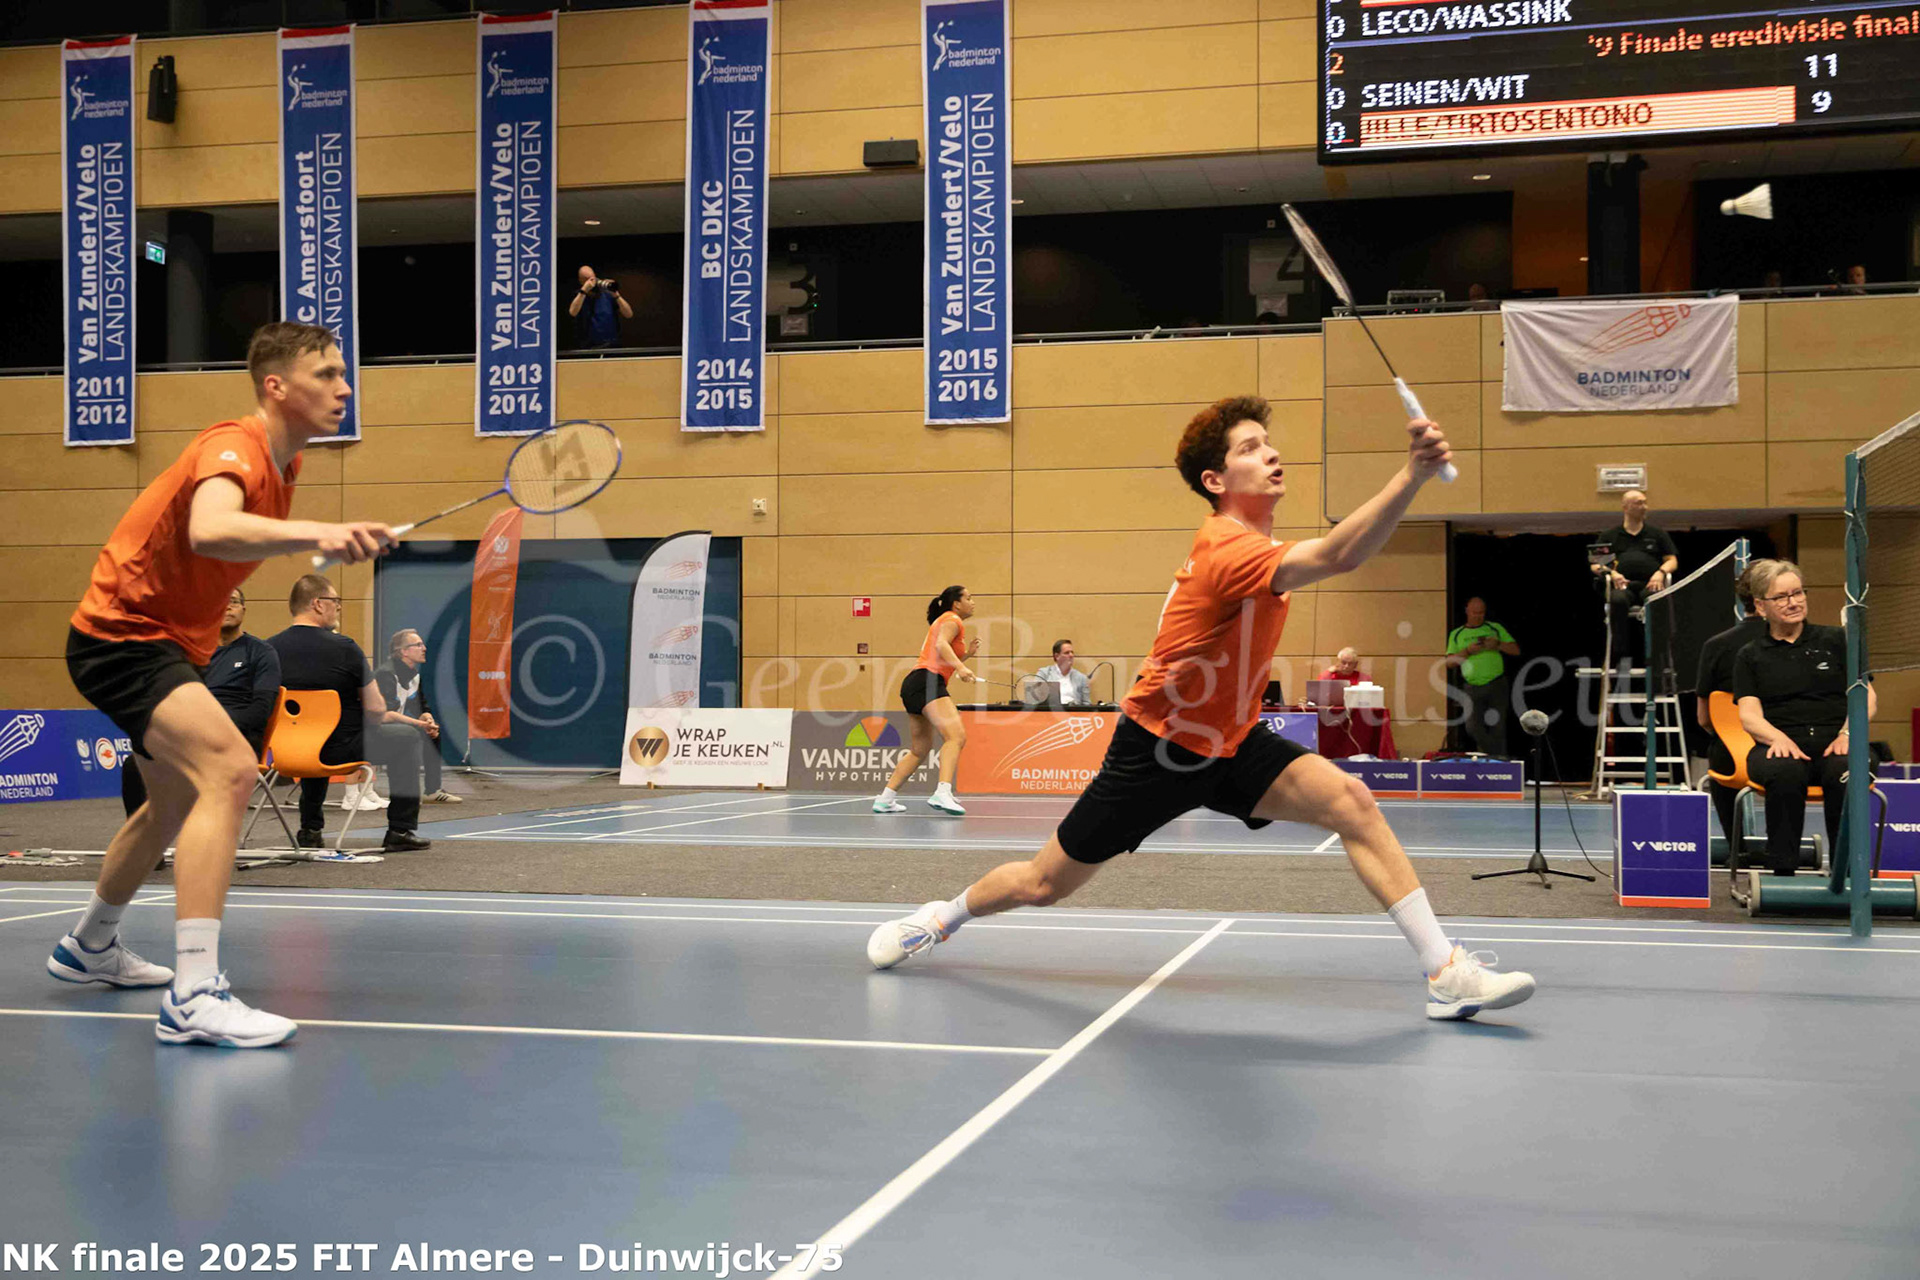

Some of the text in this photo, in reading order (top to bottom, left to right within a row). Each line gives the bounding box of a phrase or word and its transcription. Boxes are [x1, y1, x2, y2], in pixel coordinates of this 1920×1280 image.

[1361, 0, 1573, 37] LECO/WASSINK
[1620, 27, 1704, 55] Finale
[1710, 17, 1847, 49] eredivisie
[948, 47, 1001, 59] badminton
[948, 56, 996, 68] nederland
[712, 64, 763, 75] badminton
[712, 73, 758, 83] nederland
[1361, 74, 1530, 108] SEINEN/WIT
[1804, 52, 1838, 79] 11
[500, 77, 549, 88] badminton
[500, 85, 544, 95] nederland
[83, 100, 129, 111] badminton
[301, 89, 348, 100] badminton
[301, 98, 343, 108] nederland
[1811, 90, 1833, 113] 9
[938, 95, 965, 336] Van Zundert/Velo
[971, 93, 996, 332] LANDSKAMPIOEN
[295, 150, 316, 299] Amersfoort
[520, 121, 541, 348] LANDSKAMPIOEN
[701, 180, 723, 279] BC DKC
[729, 110, 755, 342] LANDSKAMPIOEN
[489, 123, 514, 351] Van Zundert/Velo
[75, 144, 98, 364] Van Zundert/Velo
[103, 142, 125, 361] LANDSKAMPIOEN
[696, 358, 753, 381] 2014
[938, 347, 998, 372] 2015
[488, 363, 543, 386] 2013
[1577, 368, 1691, 386] BADMINTON
[75, 376, 126, 397] 2011
[938, 378, 998, 402] 2016
[1589, 382, 1680, 398] NEDERLAND
[488, 393, 543, 416] 2014
[696, 388, 753, 411] 2015
[76, 403, 127, 426] 2012
[652, 587, 701, 596] BADMINTON
[648, 653, 697, 661] BADMINTON
[677, 728, 727, 742] WRAP
[673, 744, 691, 758] JE
[697, 744, 770, 758] KEUKEN
[0, 786, 54, 799] NEDERLAND
[1648, 841, 1697, 852] VICTOR
